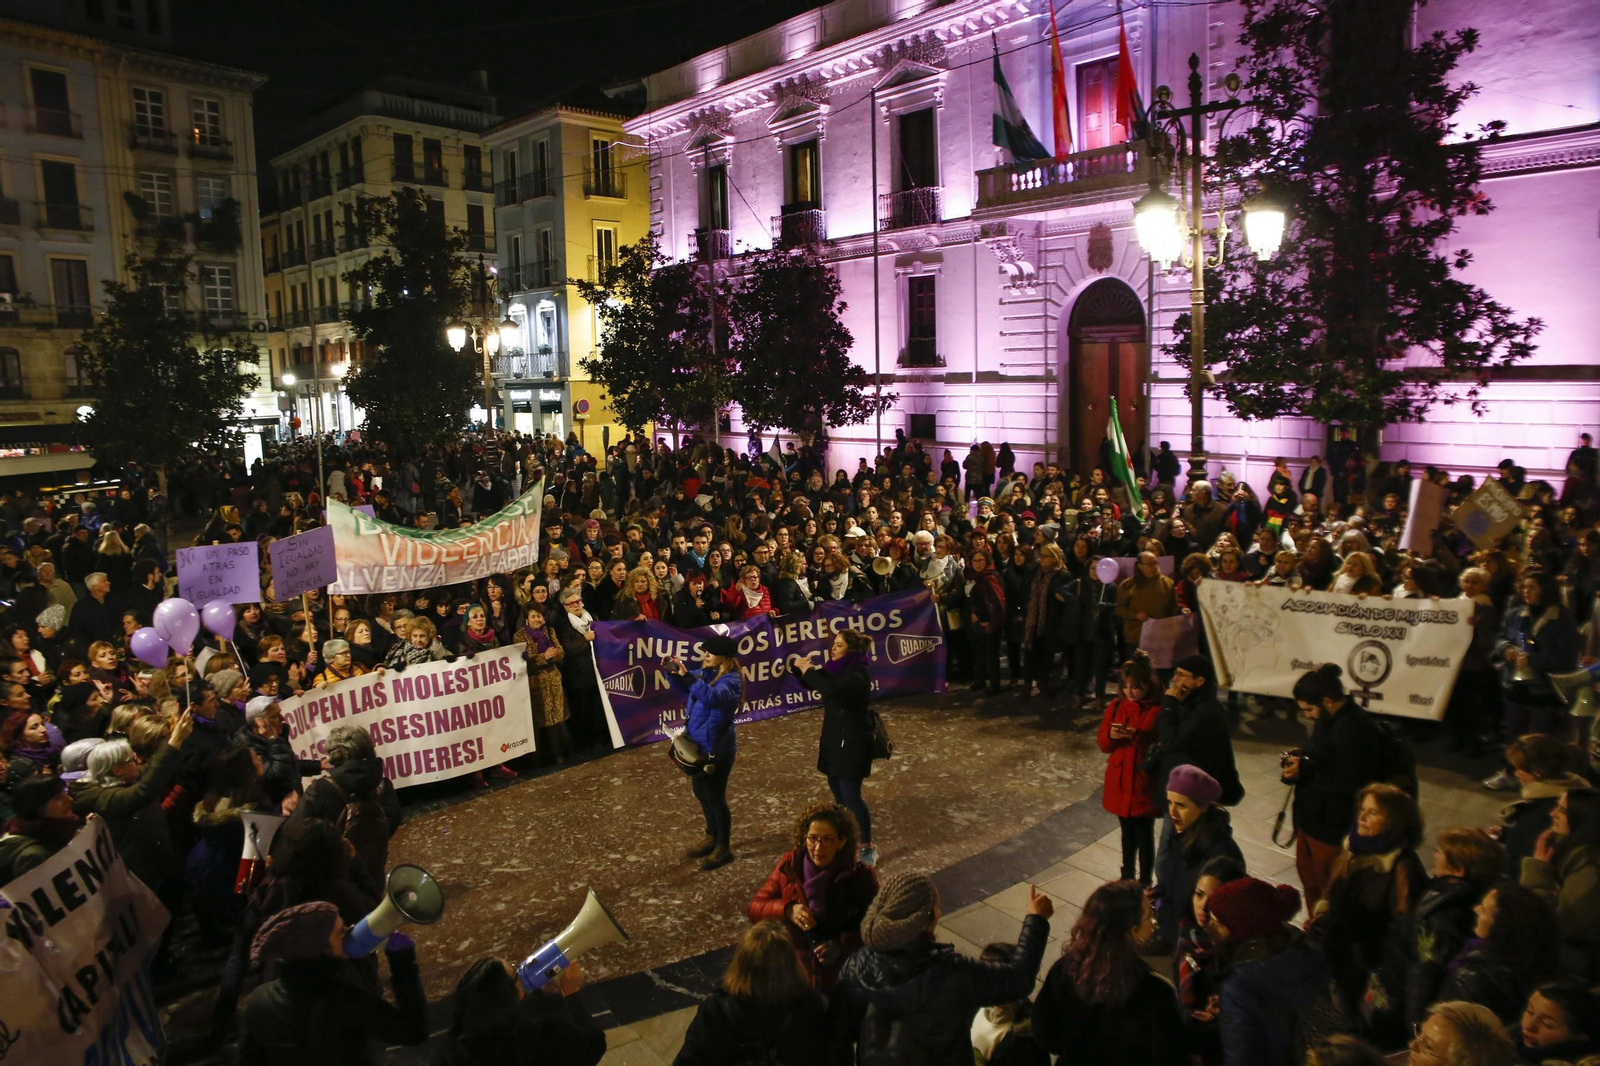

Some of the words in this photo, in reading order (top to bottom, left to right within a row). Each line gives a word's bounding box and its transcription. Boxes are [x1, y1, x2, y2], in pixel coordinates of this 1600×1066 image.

[287, 537, 309, 552] SIN
[379, 515, 530, 566] VIOLENCIA
[206, 549, 219, 560] UN
[227, 546, 250, 557] PASO
[277, 544, 324, 570] IGUALDAD
[202, 557, 236, 573] ATRÁS
[286, 568, 299, 579] NO
[304, 560, 320, 573] HAY
[208, 573, 223, 585] EN
[280, 575, 323, 598] JUSTICIA
[184, 585, 242, 603] IGUALDAD
[1281, 599, 1371, 620] ASOCIACIÓN
[1372, 607, 1395, 620] DE
[1396, 608, 1459, 626] MUJERES
[628, 631, 770, 666] ¡NUESOS
[774, 609, 903, 648] DERECHOS
[1335, 622, 1380, 638] SIGLO
[1381, 626, 1407, 640] XXI
[900, 638, 935, 657] GUADIX
[349, 681, 388, 716] LAS
[392, 655, 518, 704] MOLESTIAS,
[604, 672, 635, 693] GUADIX
[741, 693, 782, 713] ATRÁS
[786, 691, 804, 704] EN
[369, 694, 507, 747] ASESINANDO
[381, 736, 485, 782] MUJERES!
